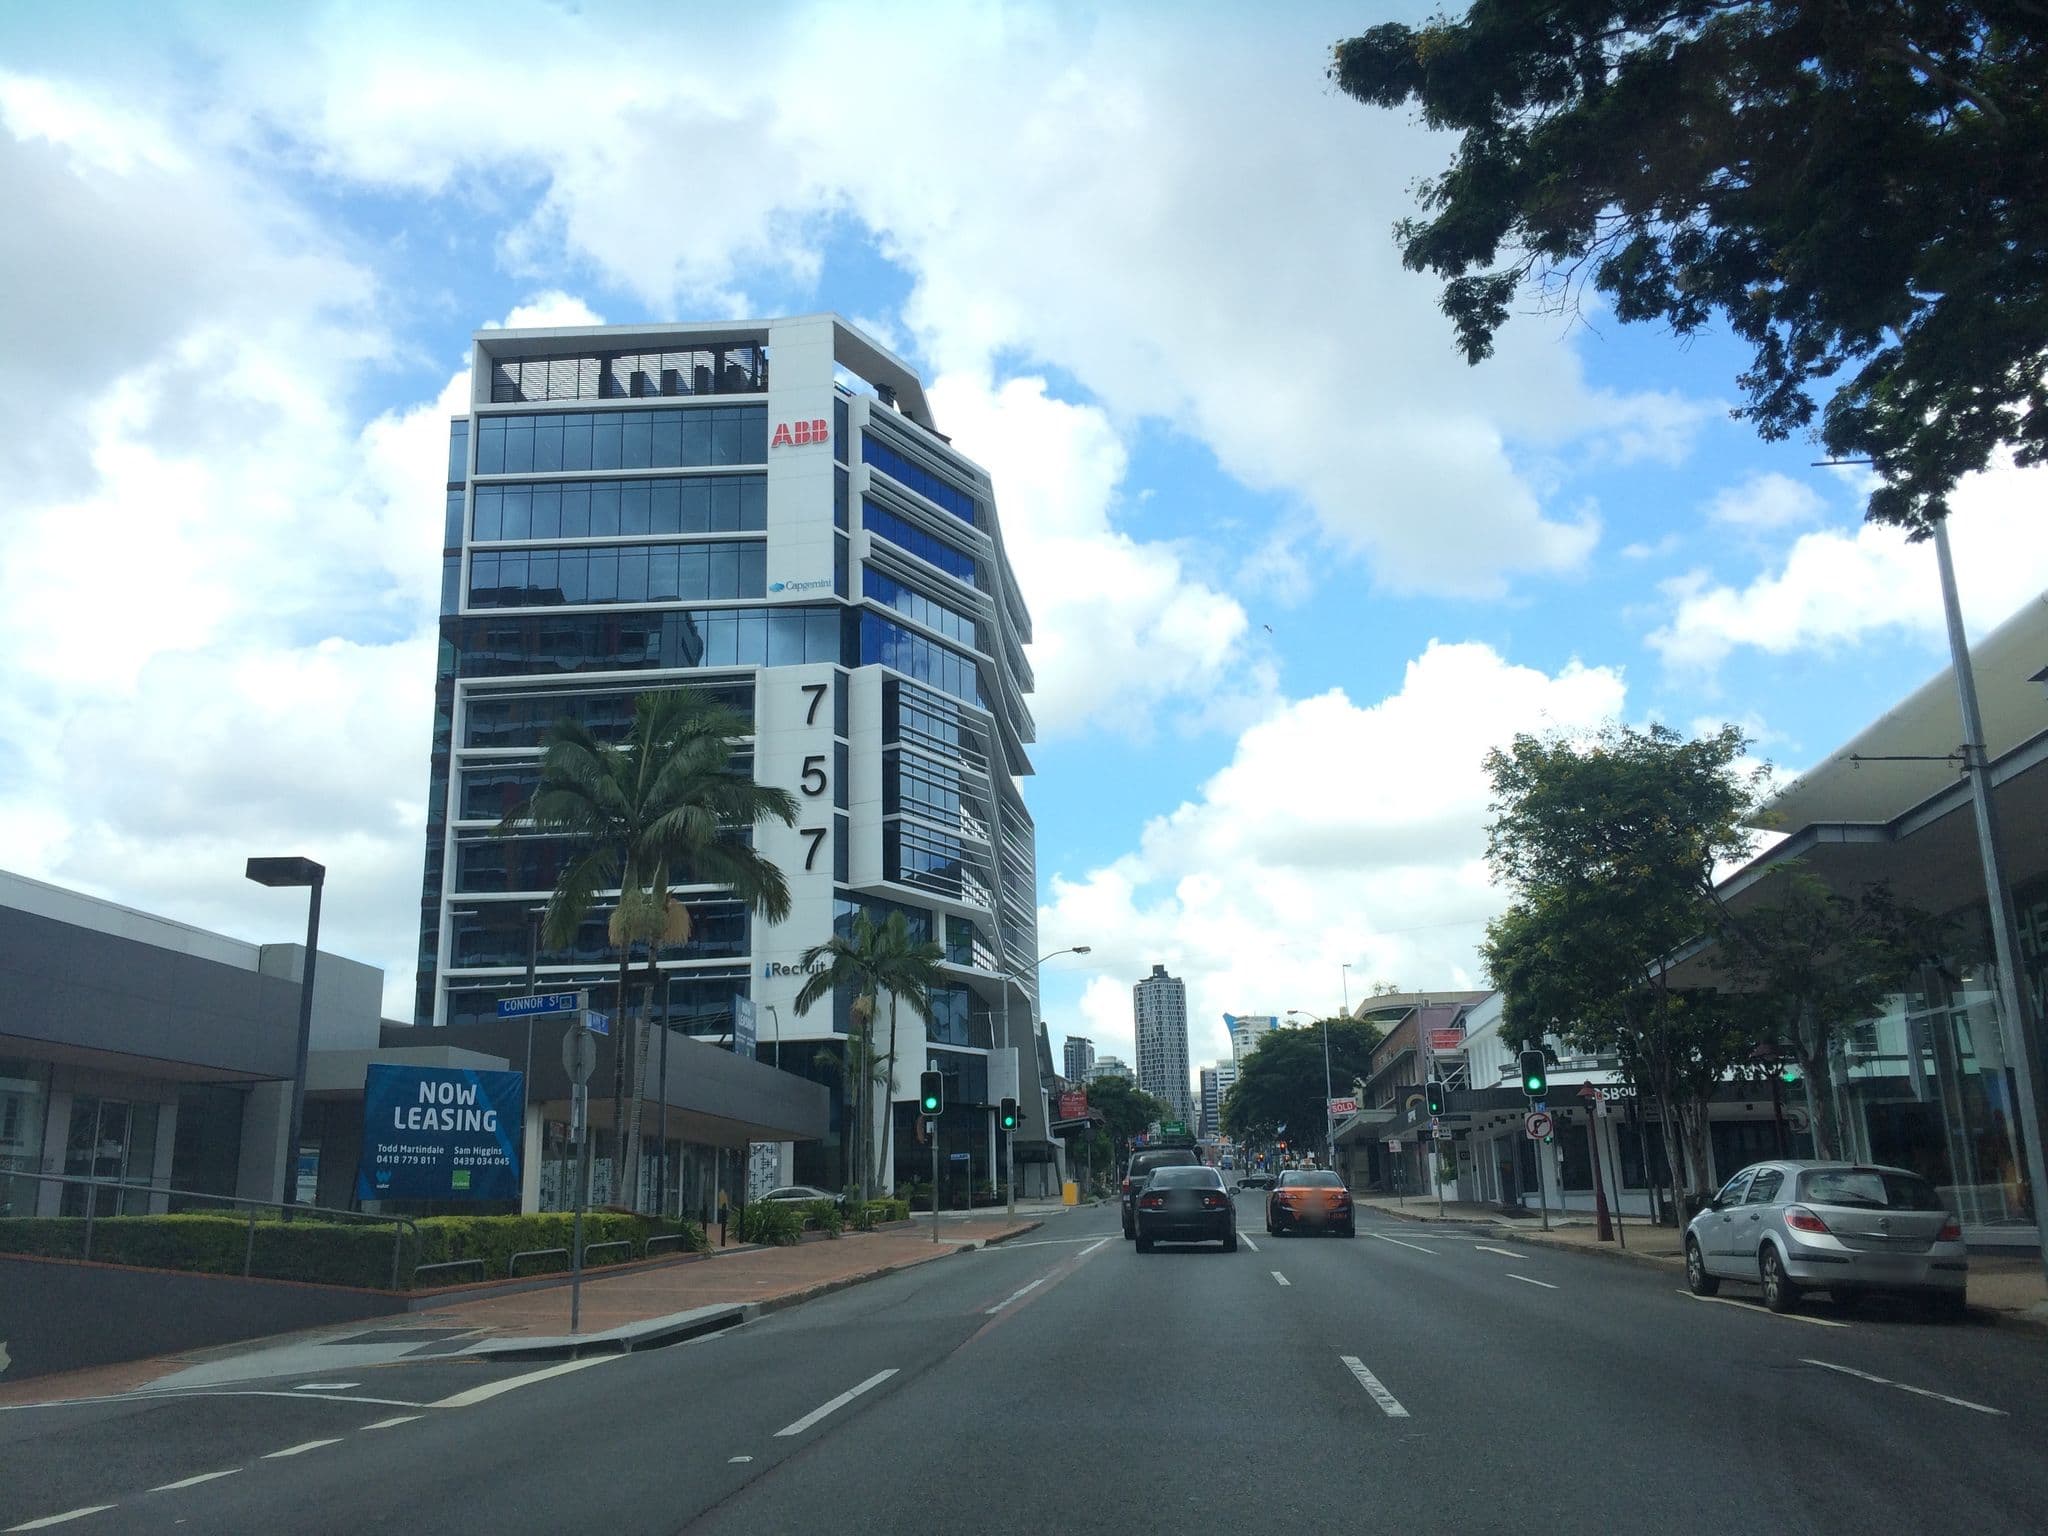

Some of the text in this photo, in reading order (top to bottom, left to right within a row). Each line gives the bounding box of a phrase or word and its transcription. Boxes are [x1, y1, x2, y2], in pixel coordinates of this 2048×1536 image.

[771, 419, 829, 448] ABB
[786, 578, 832, 595] Capgemini
[504, 997, 543, 1011] CONNOR
[419, 1081, 477, 1106] NOW
[1332, 1102, 1353, 1113] SOLD
[394, 1106, 497, 1132] LEASING
[377, 1144, 445, 1154] Todd Martindale
[454, 1146, 502, 1157] Sam Higgins
[376, 1155, 436, 1165] 0418 779 811
[453, 1157, 510, 1166] 0439 034 045
